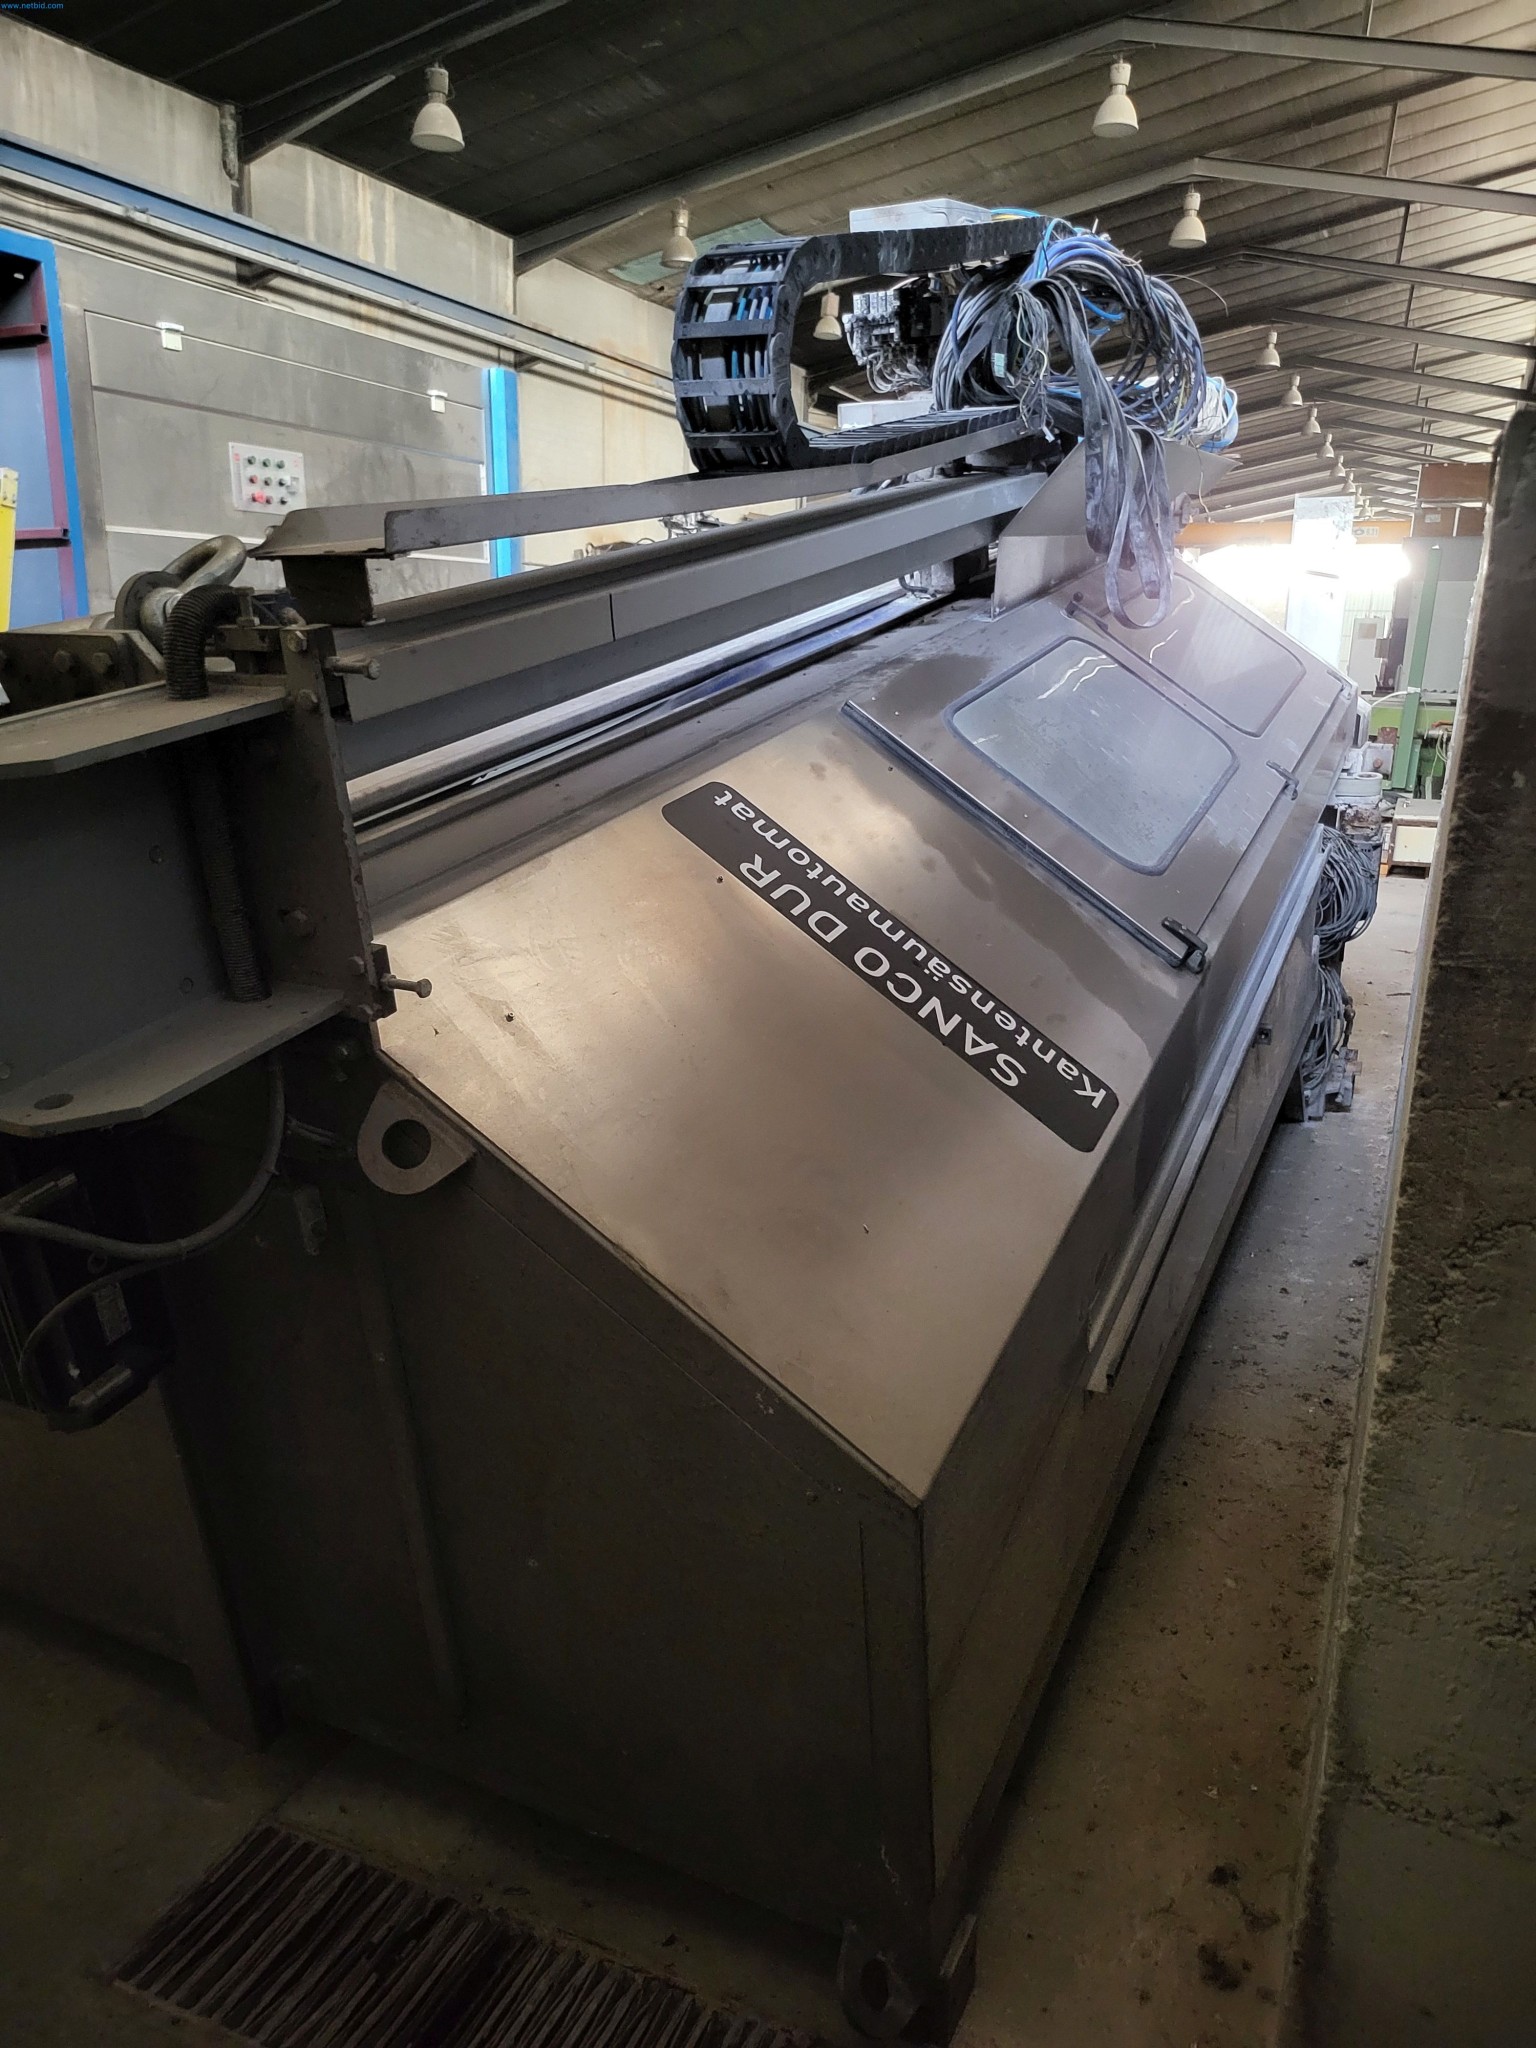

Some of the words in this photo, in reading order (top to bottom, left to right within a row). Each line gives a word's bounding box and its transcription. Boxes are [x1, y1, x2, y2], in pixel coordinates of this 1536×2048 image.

[714, 790, 1107, 1109] Kantensäumautomat
[739, 854, 848, 943] DUR
[854, 947, 1027, 1087] SANCO
